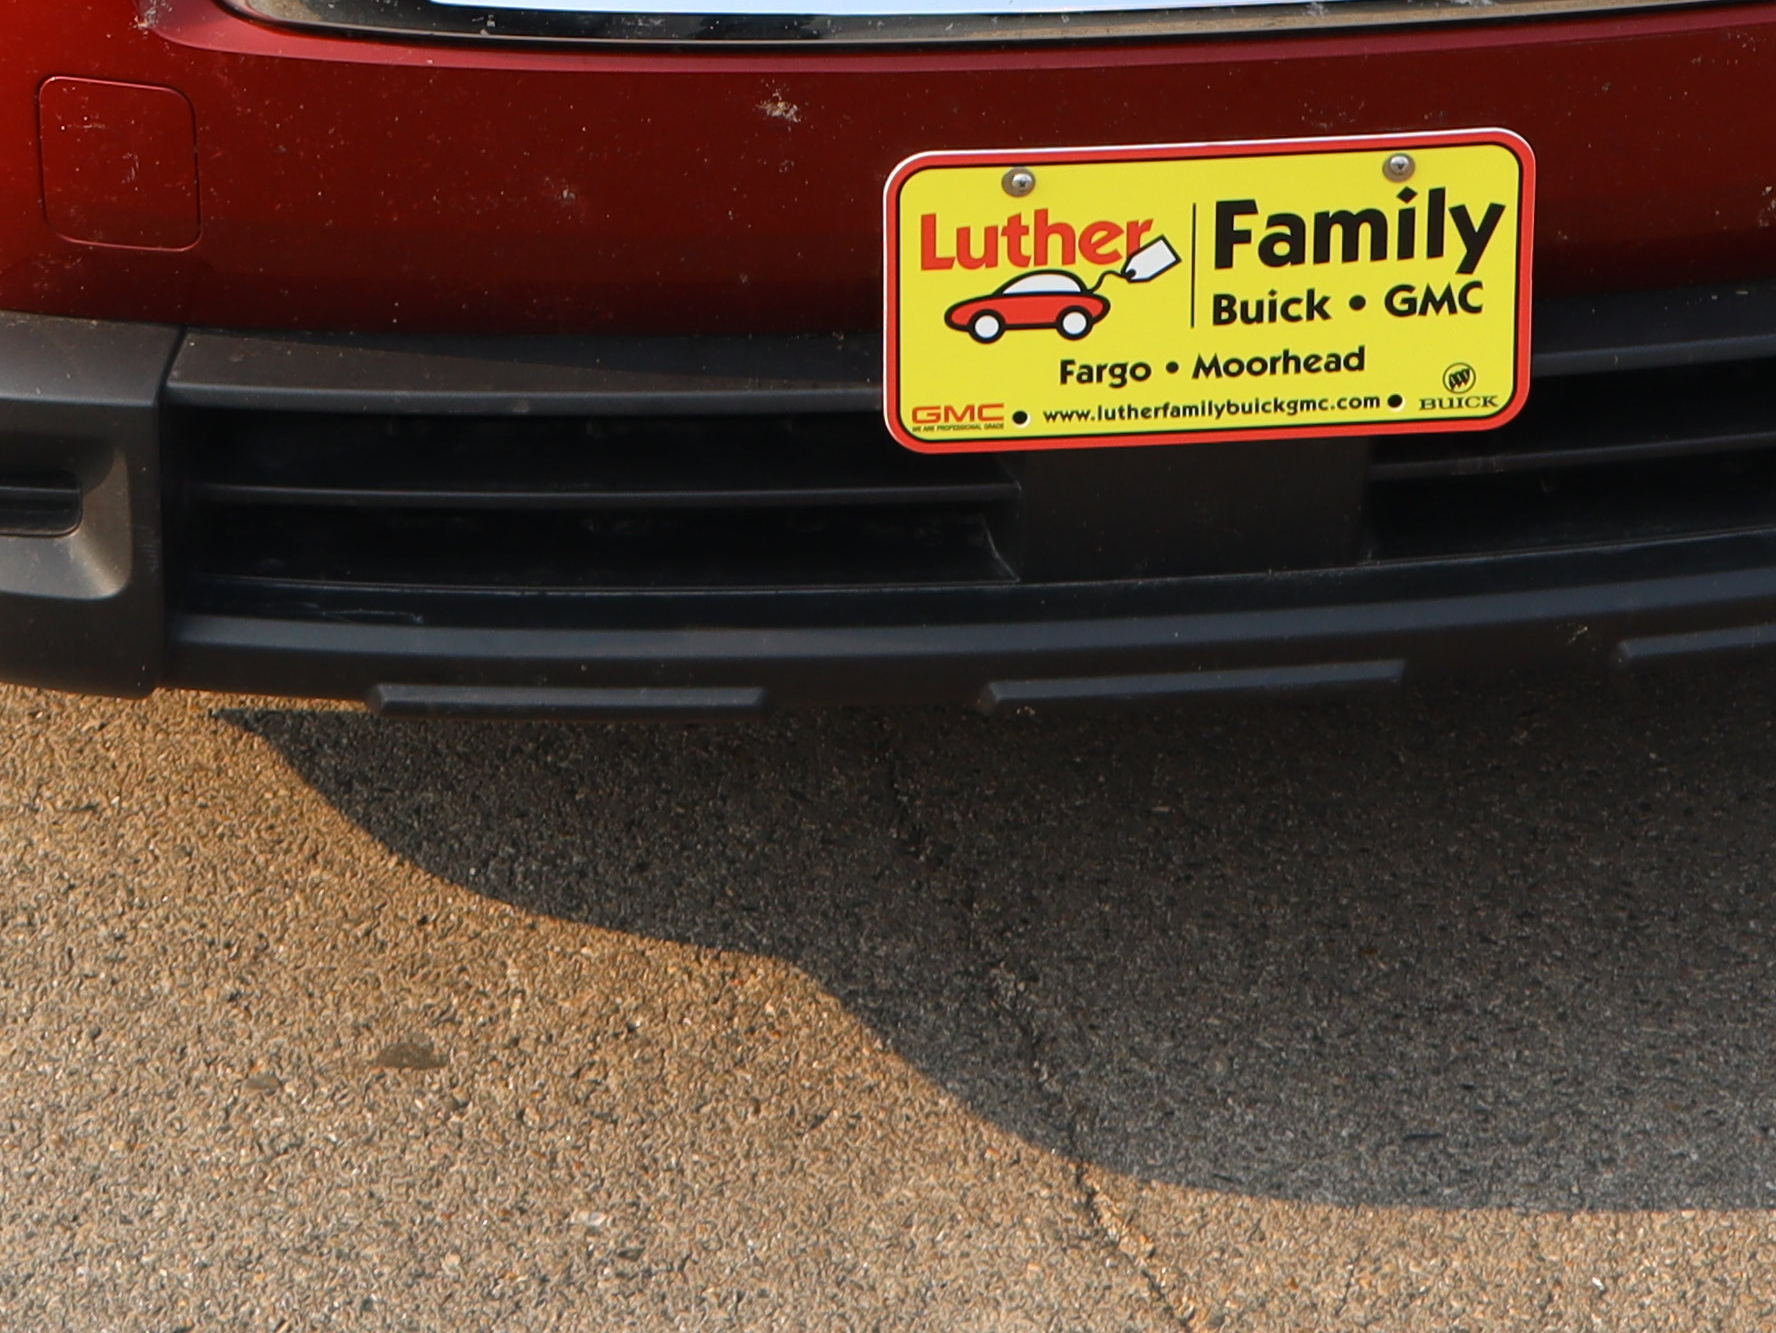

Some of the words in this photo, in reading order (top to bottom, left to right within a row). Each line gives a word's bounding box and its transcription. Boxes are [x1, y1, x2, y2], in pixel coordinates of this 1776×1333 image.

[920, 207, 1154, 272] Luther
[1213, 186, 1506, 275] Family
[1211, 288, 1332, 327] Buick
[1384, 281, 1485, 318] GMC
[1059, 359, 1152, 389] Fargo
[1191, 345, 1366, 380] Moorhead
[912, 403, 1004, 424] GMC
[1042, 395, 1381, 424] www.lutherfamilybuickgmc.com
[1418, 395, 1499, 411] BUICK
